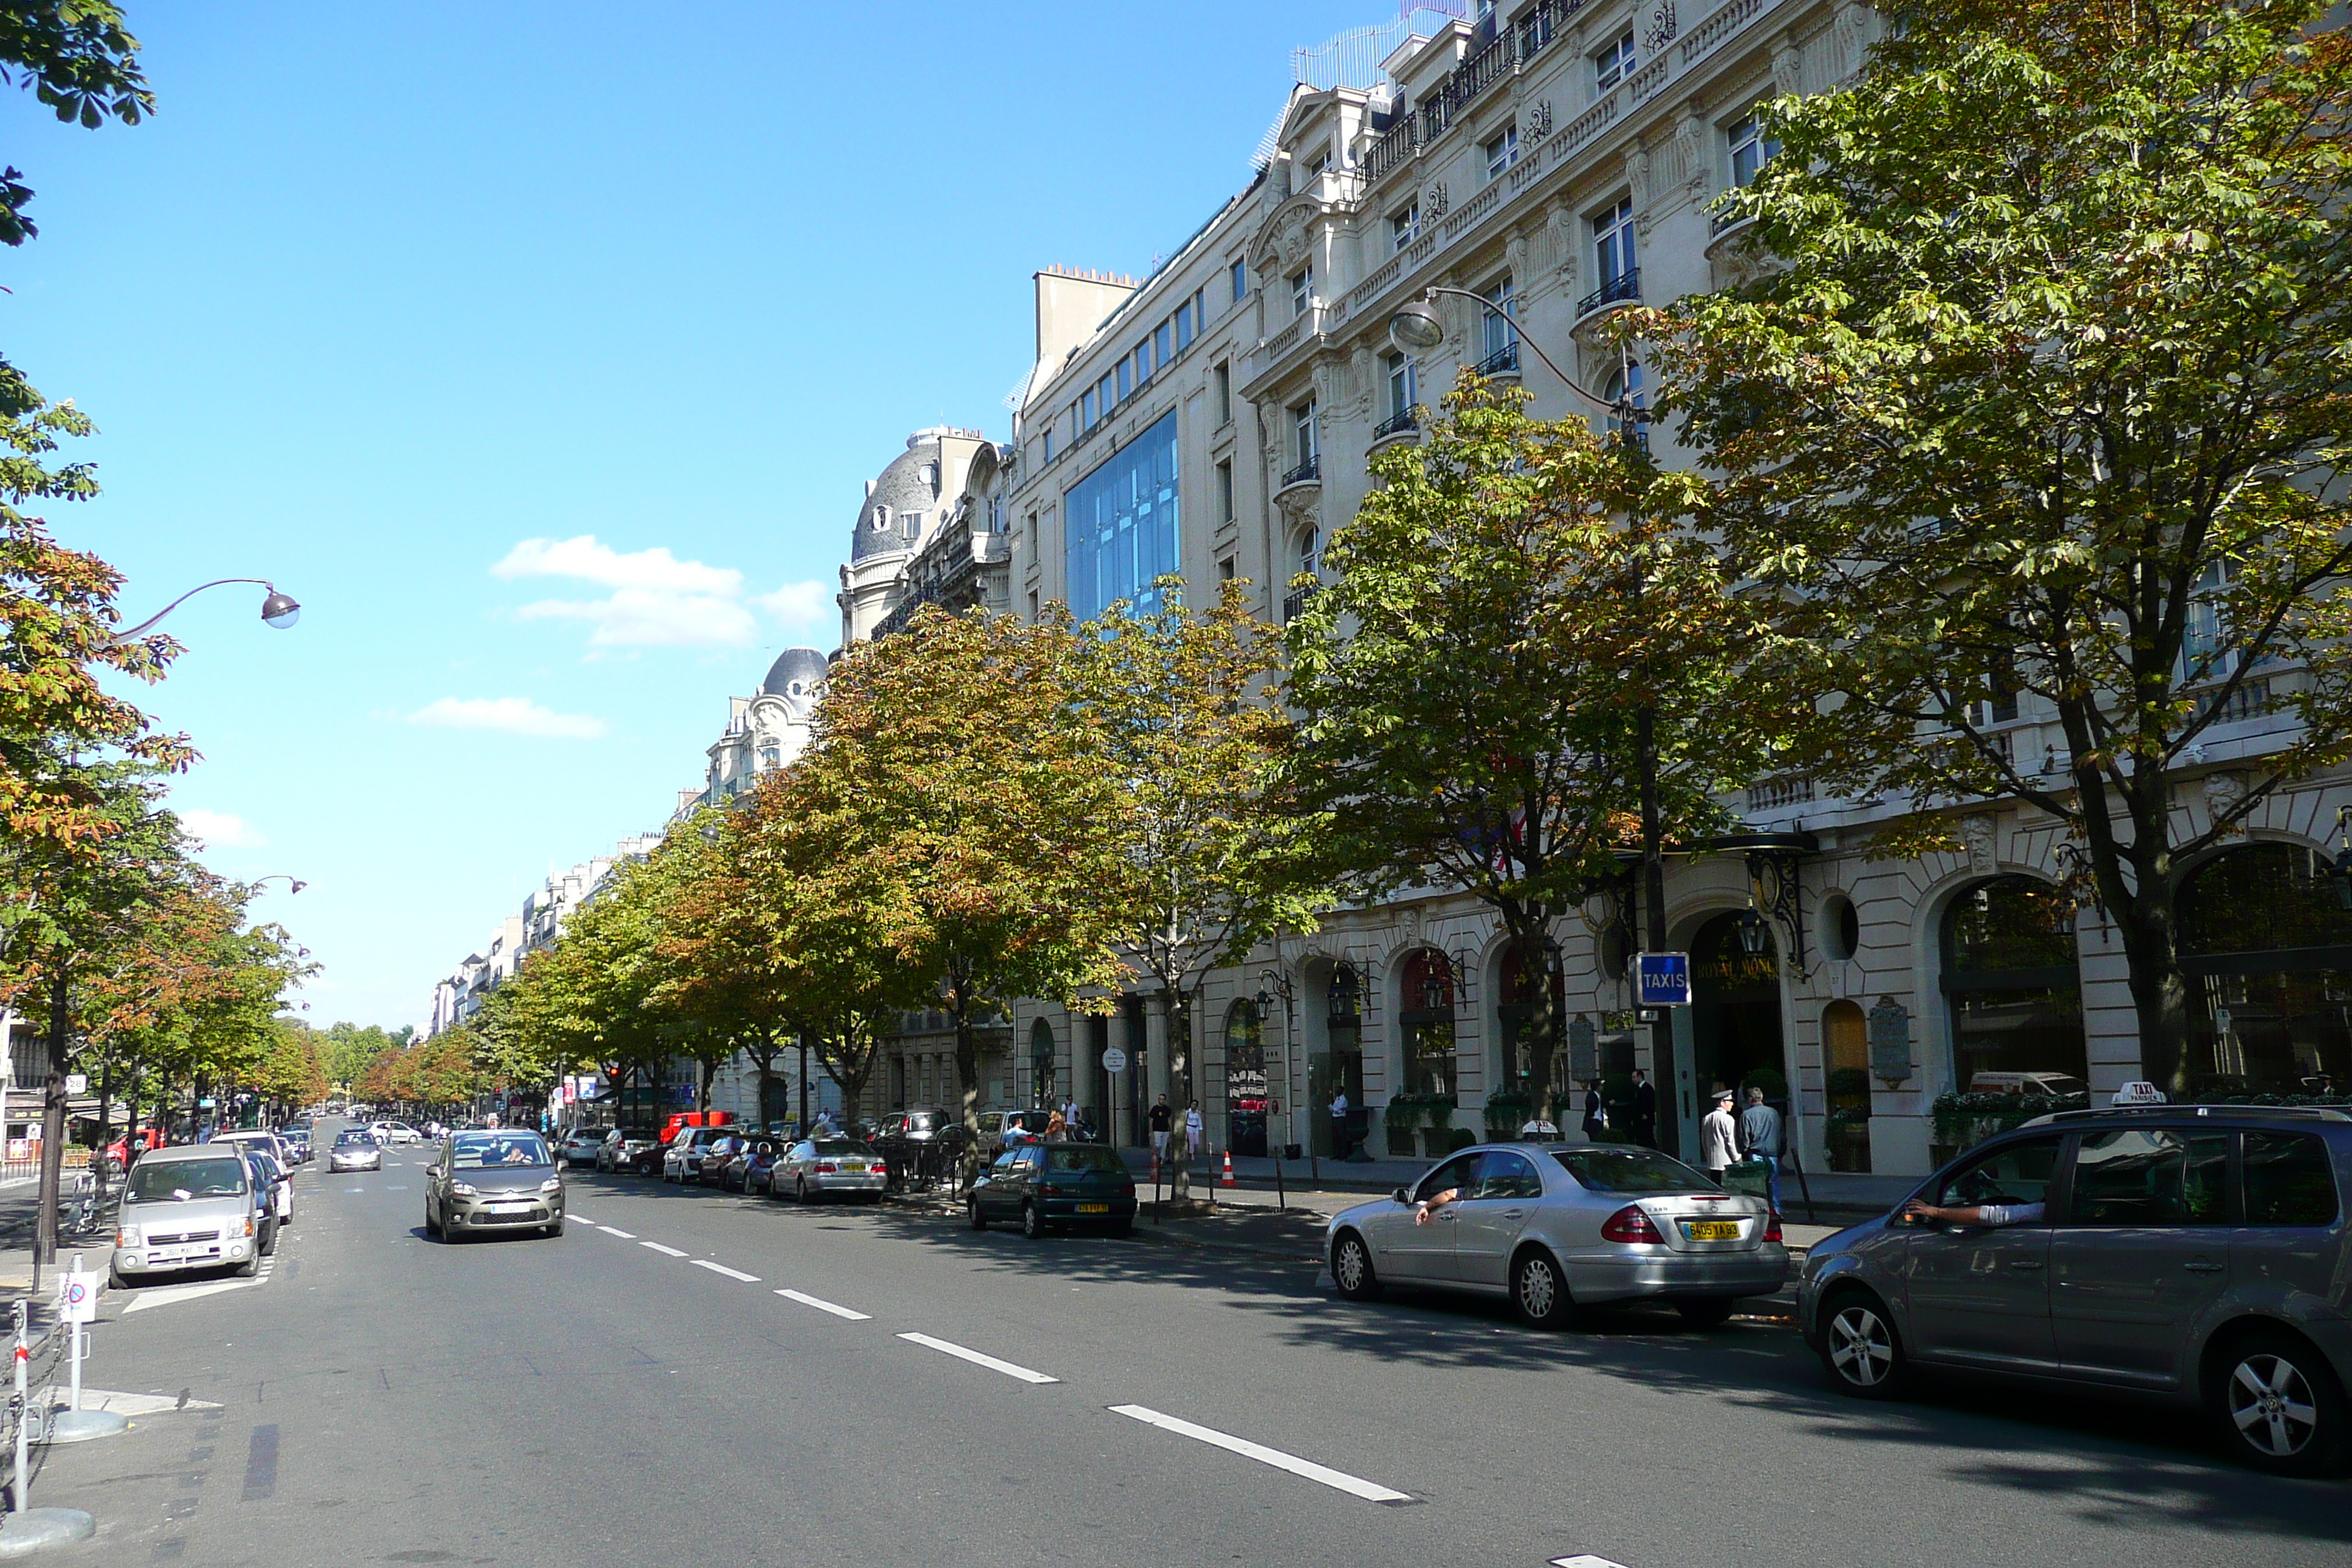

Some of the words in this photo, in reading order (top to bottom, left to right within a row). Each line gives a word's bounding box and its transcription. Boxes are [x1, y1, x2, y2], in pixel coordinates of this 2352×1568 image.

[1697, 960, 1733, 979] ROYAL
[1644, 973, 1685, 988] TAXIS
[69, 1079, 82, 1088] 28
[2133, 1084, 2152, 1095] TAXI
[1689, 1224, 1711, 1236] 6405
[1713, 1224, 1725, 1236] YA
[1726, 1224, 1738, 1235] 93
